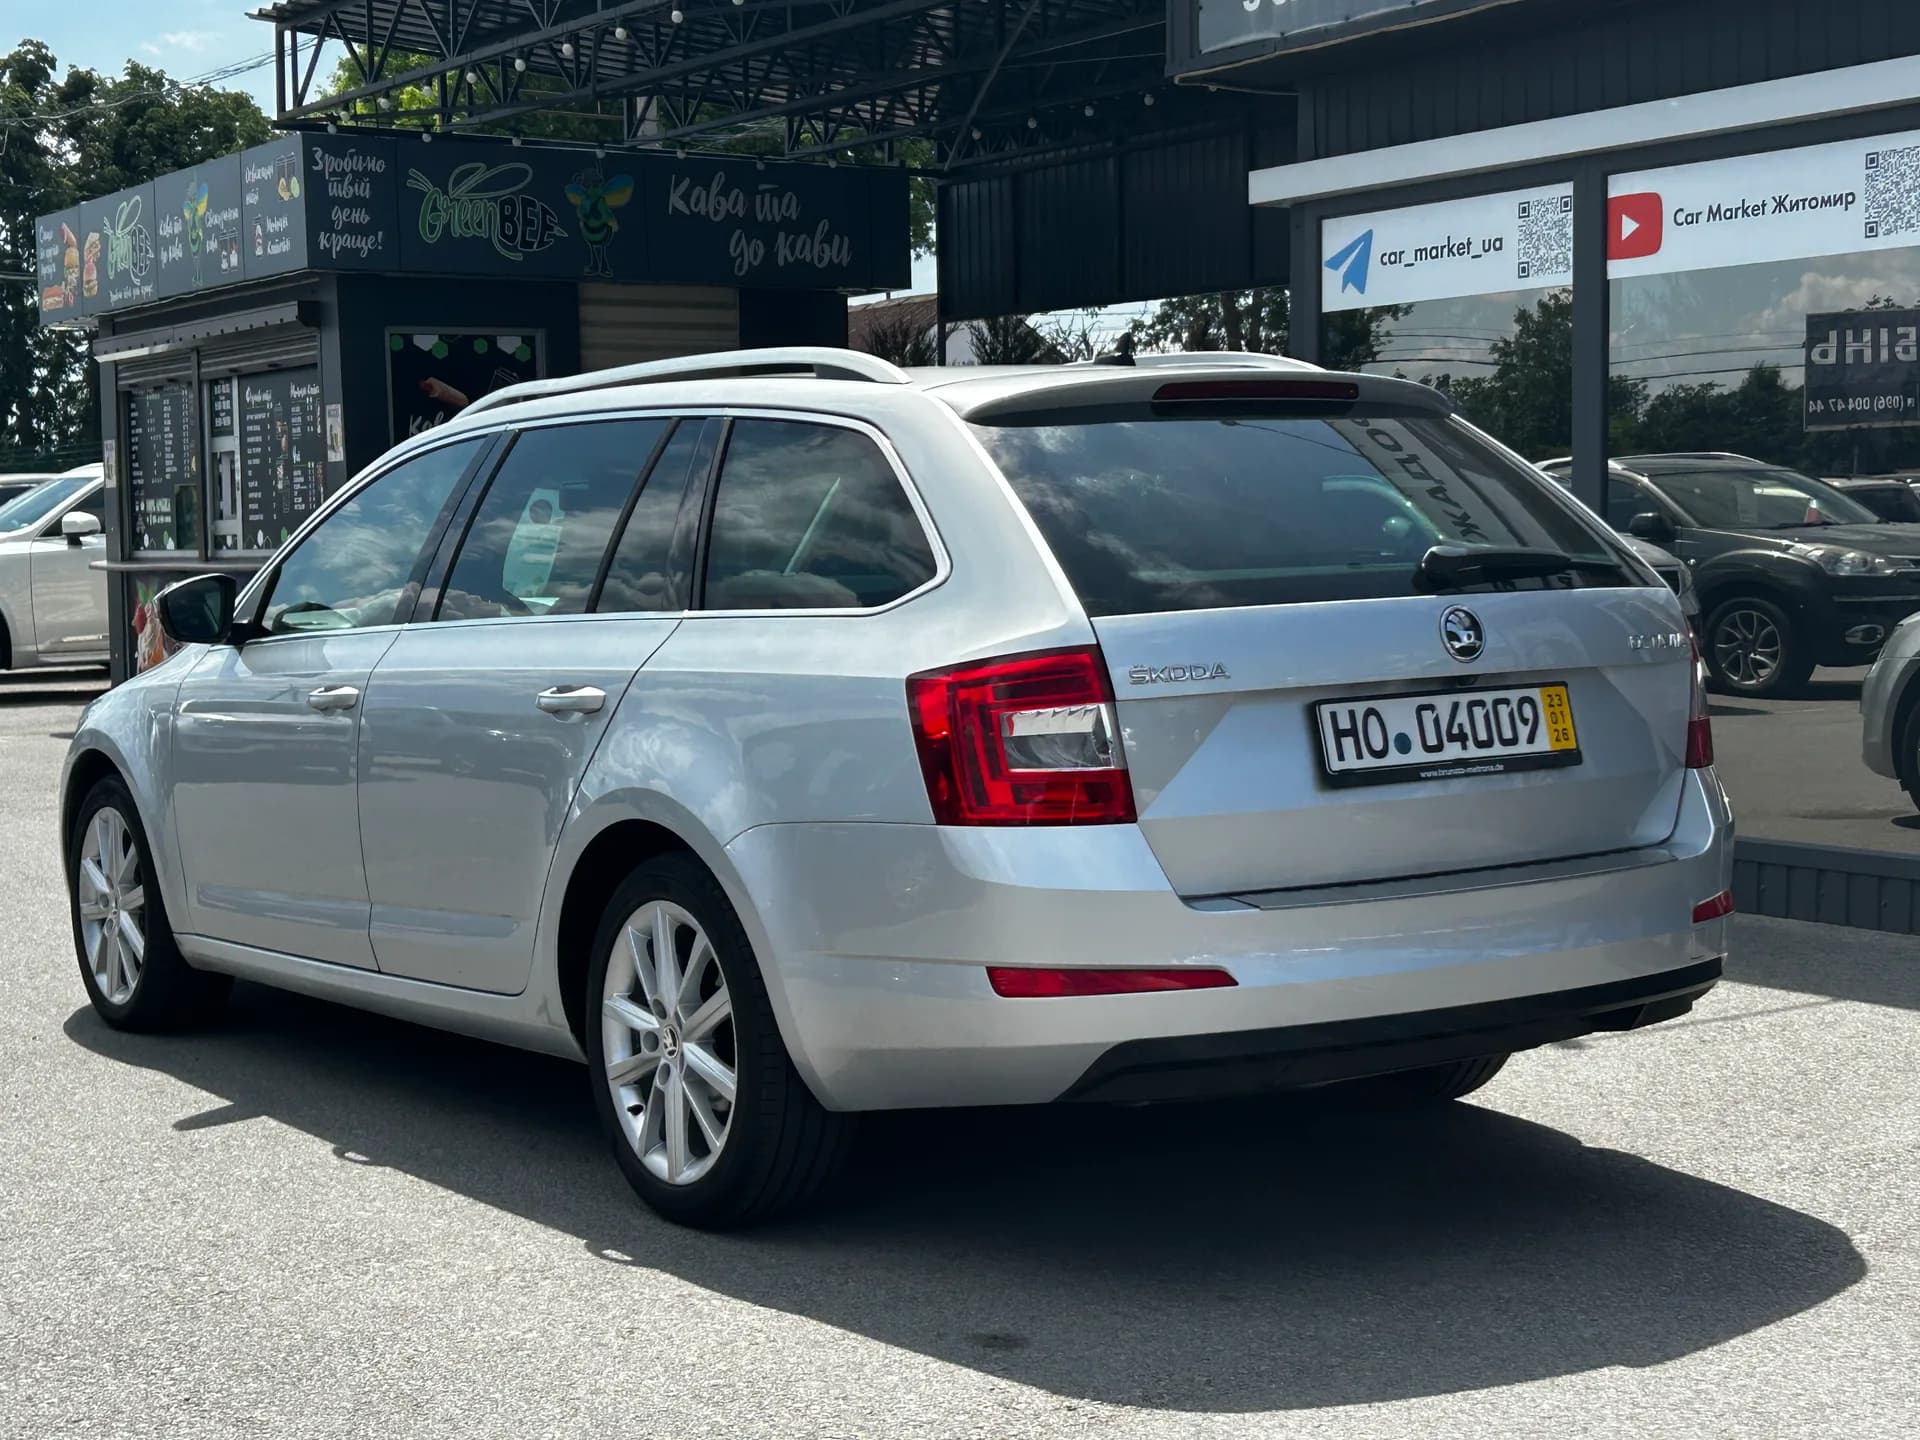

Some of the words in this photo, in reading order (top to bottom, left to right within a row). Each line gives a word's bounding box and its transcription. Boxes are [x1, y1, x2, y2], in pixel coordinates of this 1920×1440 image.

[312, 147, 385, 180] Зробимо
[328, 173, 370, 199] твій
[668, 171, 747, 222] Кава
[754, 183, 800, 223] та
[331, 205, 371, 230] день
[1673, 208, 1702, 226] Car
[1706, 199, 1768, 223] Market
[1771, 191, 1856, 215] Житомир
[318, 231, 383, 259] краще!
[729, 229, 765, 276] до
[775, 219, 852, 268] кави
[1380, 236, 1503, 267] car_market_ua
[1547, 693, 1563, 708] 23
[1330, 707, 1389, 762] HO
[1415, 695, 1540, 754] 04009
[1550, 711, 1566, 725] 01
[1554, 728, 1570, 742] 26
